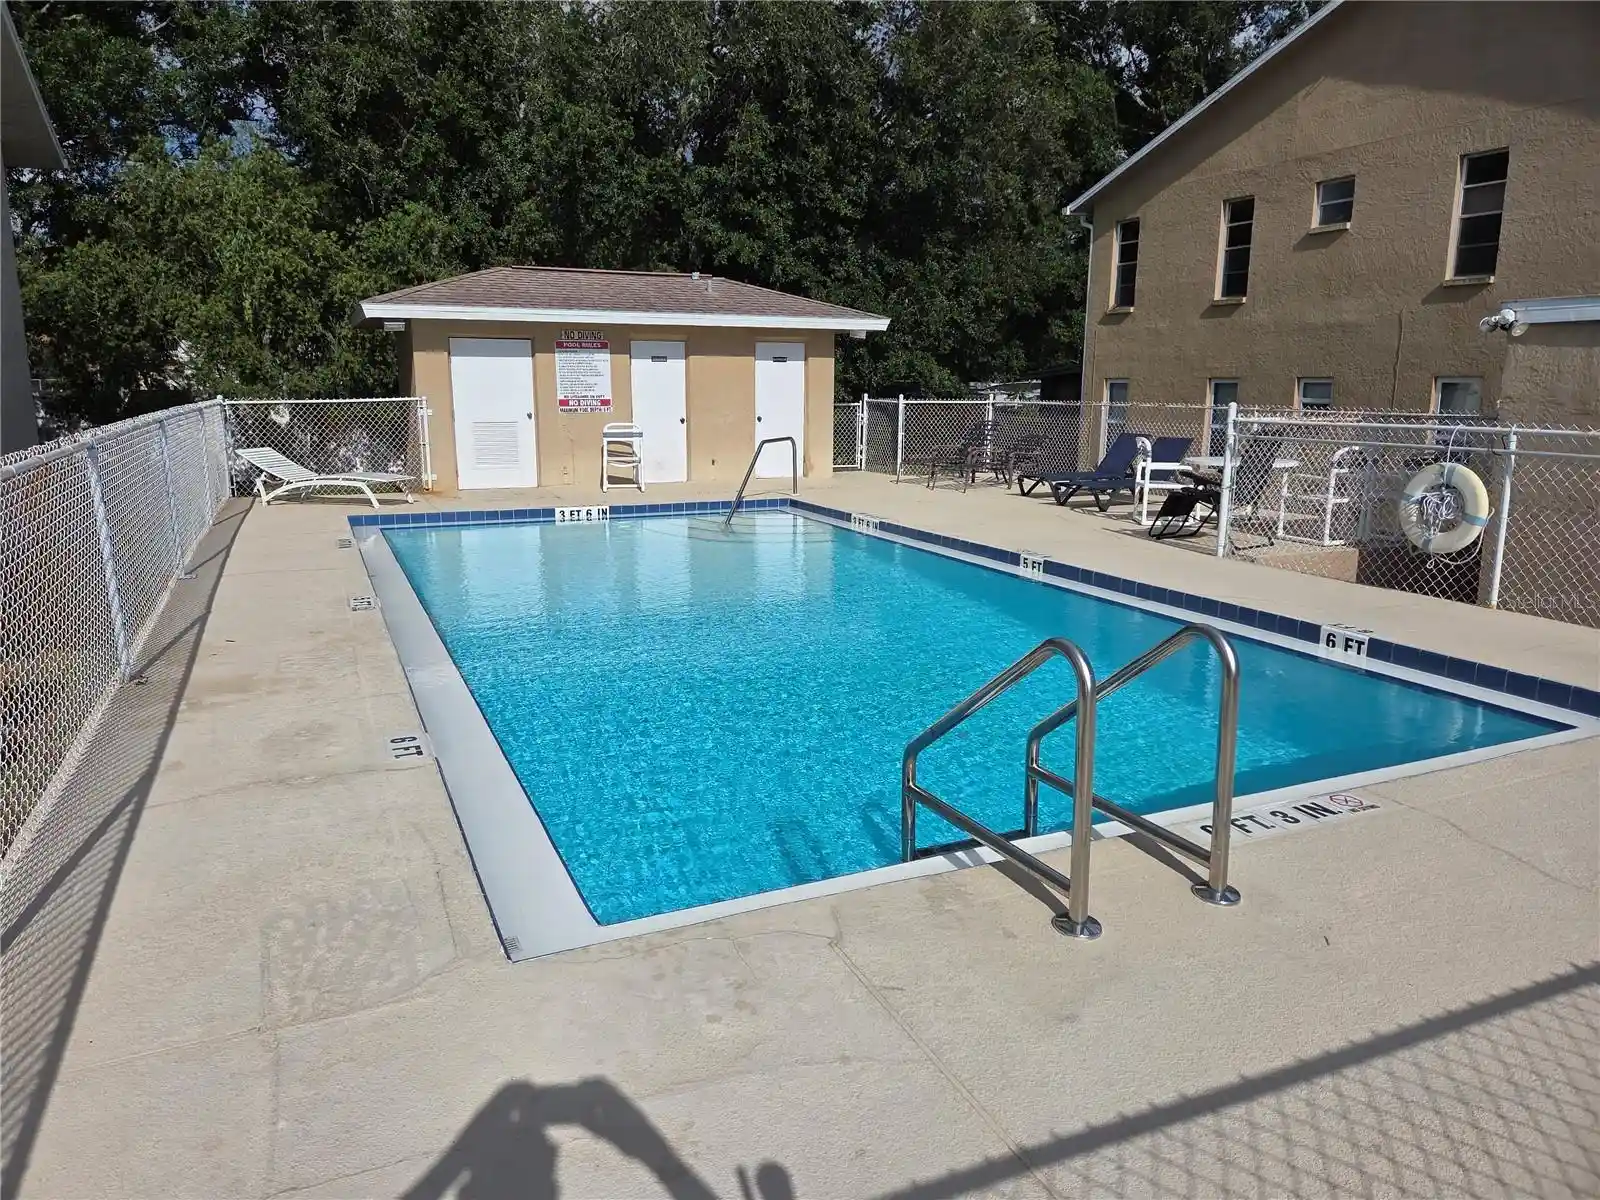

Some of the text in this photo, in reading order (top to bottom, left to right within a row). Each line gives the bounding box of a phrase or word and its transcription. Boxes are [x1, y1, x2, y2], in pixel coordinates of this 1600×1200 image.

[564, 331, 602, 340] NO DIVING
[559, 510, 566, 522] 3
[586, 509, 592, 521] 6
[597, 508, 608, 521] IN
[1023, 557, 1042, 572] 5 FT
[1326, 632, 1366, 656] 6 FT
[390, 736, 418, 744] 6
[1269, 810, 1301, 824] 3
